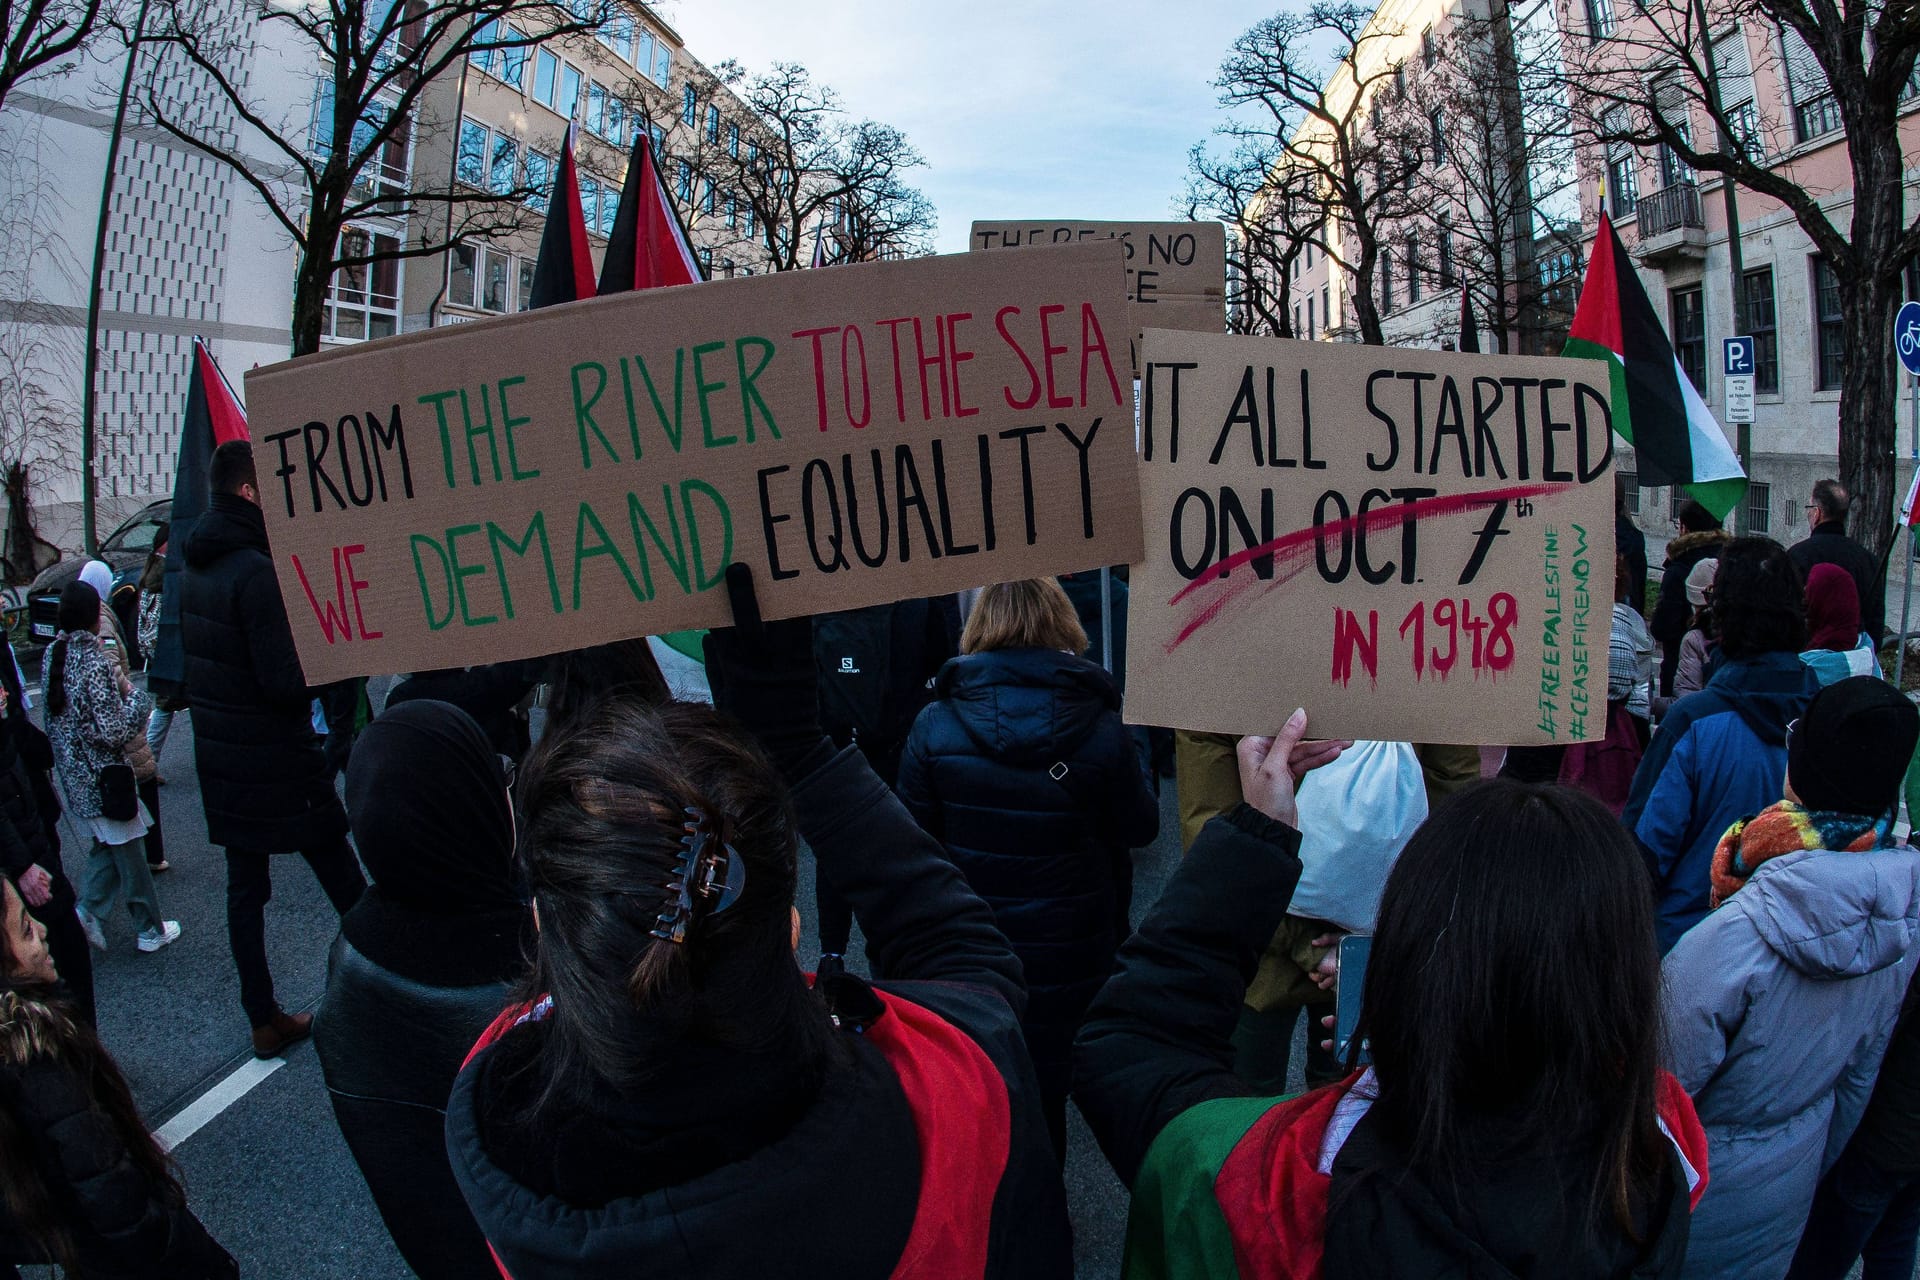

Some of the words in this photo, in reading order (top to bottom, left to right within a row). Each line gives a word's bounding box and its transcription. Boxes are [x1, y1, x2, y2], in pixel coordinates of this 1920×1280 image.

[1148, 233, 1197, 266] NO
[264, 404, 414, 518] FROM
[418, 376, 540, 489] THE
[571, 336, 782, 469] RIVER
[792, 325, 871, 432] TO
[876, 312, 979, 423] THE
[995, 302, 1123, 411] SEA
[1728, 342, 1744, 370] P
[1144, 362, 1197, 463] IT
[1209, 365, 1326, 469] ALL
[1365, 369, 1613, 484] STARTED
[292, 544, 383, 645] WE
[410, 478, 734, 632] DEMAND
[757, 418, 1102, 581] EQUALITY
[1169, 486, 1275, 581] ON
[1332, 606, 1378, 690] IN
[1399, 592, 1517, 682] 1948
[1569, 523, 1591, 741] #CEASEFIRENOW
